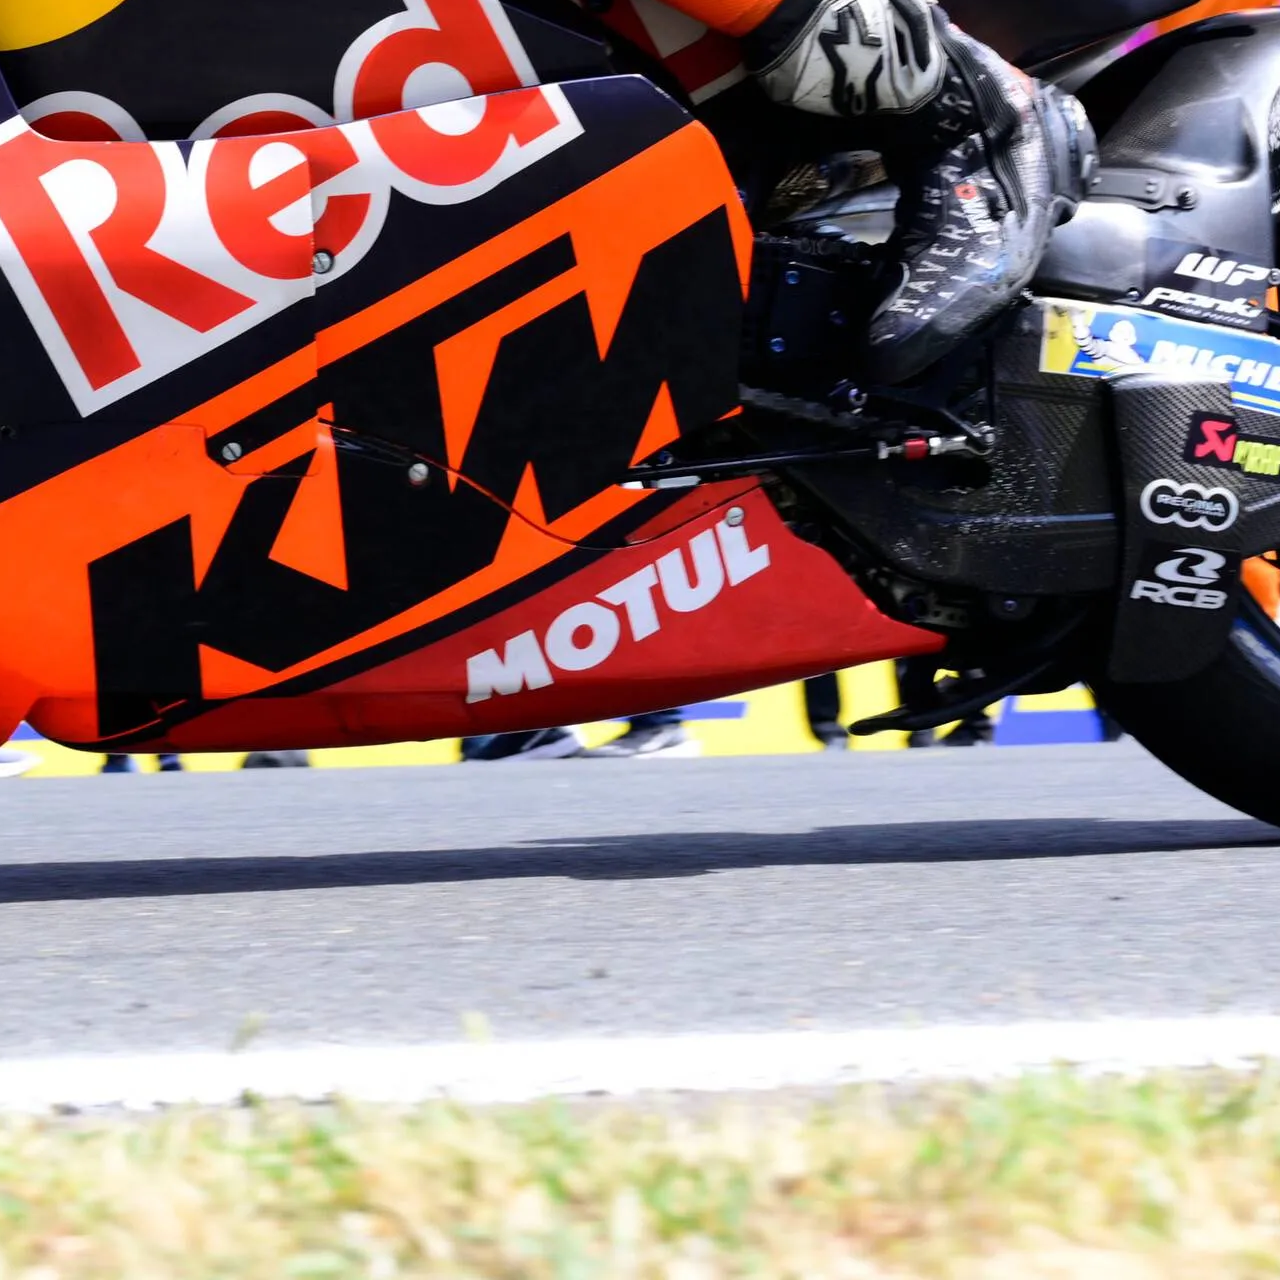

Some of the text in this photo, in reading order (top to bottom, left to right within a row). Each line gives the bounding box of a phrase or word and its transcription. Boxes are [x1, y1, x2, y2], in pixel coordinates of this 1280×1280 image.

[1173, 251, 1271, 287] WP
[89, 204, 745, 740] KTM
[465, 506, 770, 705] MOTUL
[1129, 579, 1229, 610] RCB
